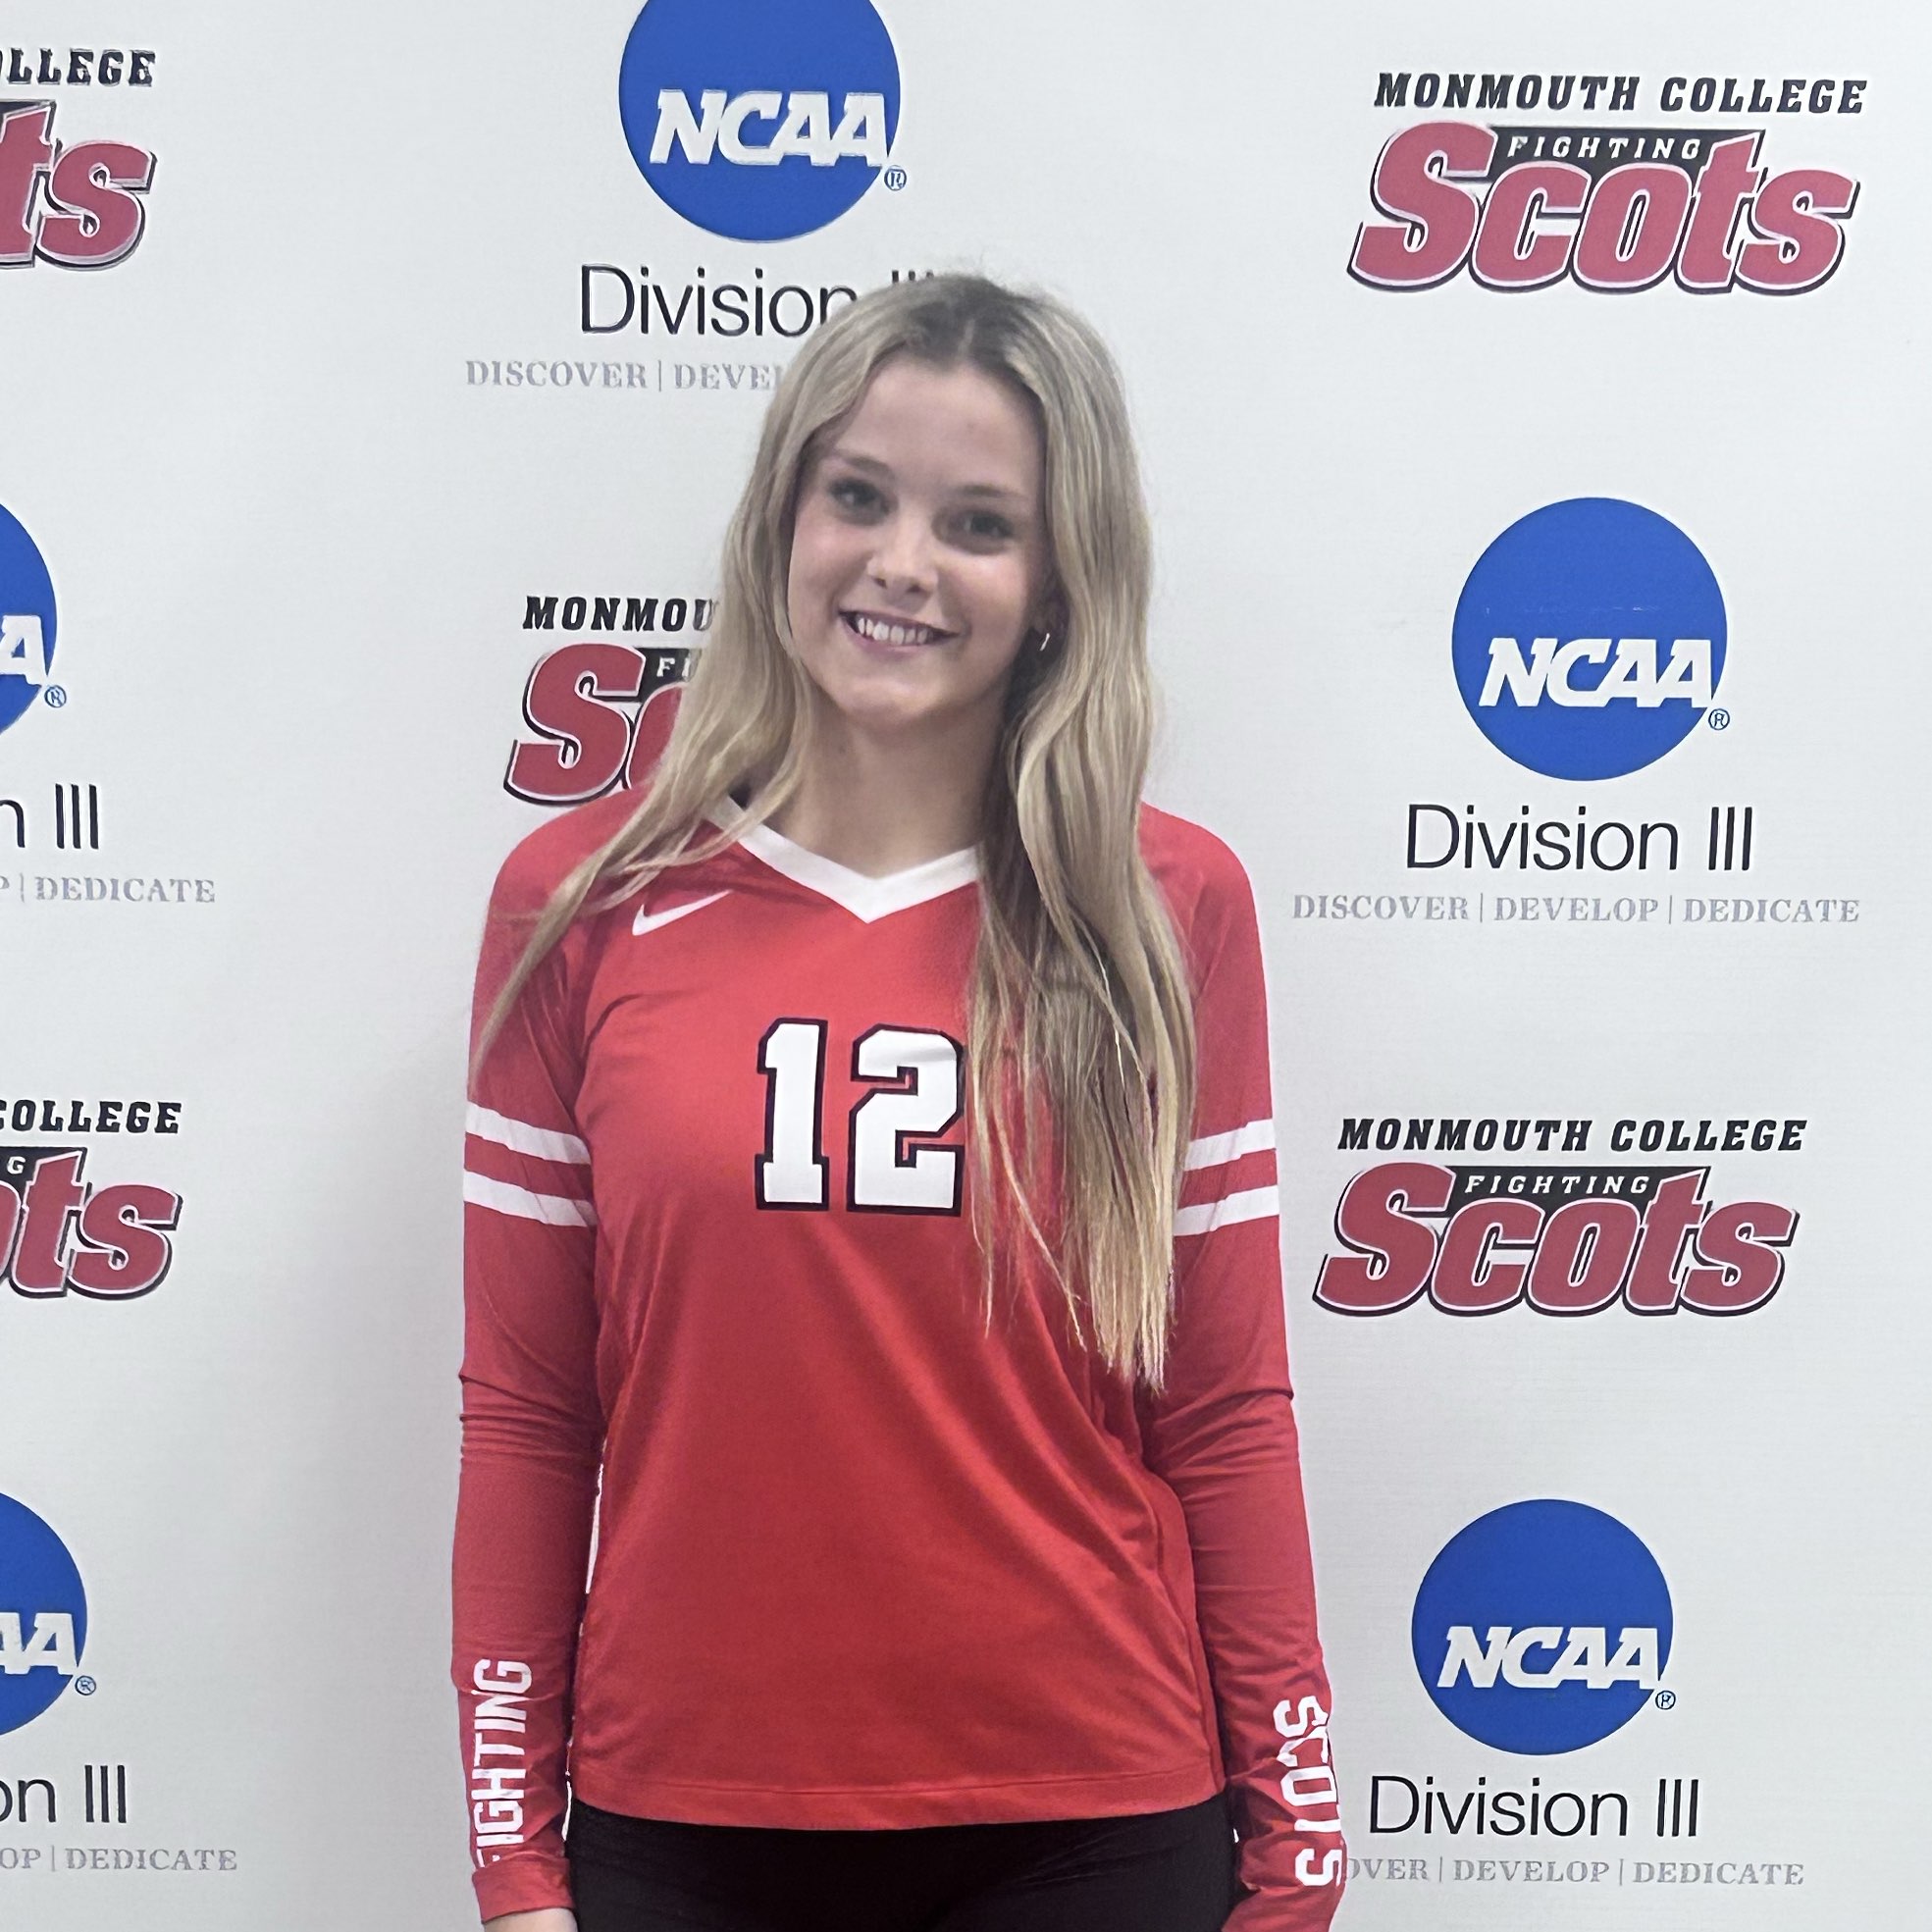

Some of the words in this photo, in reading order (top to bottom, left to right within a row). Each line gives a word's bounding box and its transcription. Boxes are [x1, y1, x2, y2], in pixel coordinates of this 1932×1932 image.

[0, 47, 156, 87] LLEGE
[1374, 72, 1641, 111] MONMOUTH
[1660, 78, 1868, 115] COLLEGE
[649, 88, 887, 168] NCAA
[1507, 135, 1700, 160] FIGHTING
[1346, 120, 1861, 296] Scots
[465, 359, 648, 390] DISCOVER
[1478, 637, 1713, 709] NCAA
[55, 783, 99, 850] III
[1407, 804, 1679, 871] Division
[1708, 806, 1753, 871] III
[34, 876, 216, 904] DEDICATE
[1291, 894, 1470, 921] DISCOVER
[1493, 896, 1659, 922] DEVELOP
[1683, 898, 1860, 924] DEDICATE
[755, 1018, 966, 1217] 12
[1337, 1118, 1593, 1152] MONMOUTH
[1610, 1120, 1808, 1153] COLLEGE
[1465, 1175, 1650, 1194] FIGHTING
[1312, 1162, 1801, 1318] Scots
[1436, 1625, 1660, 1691] NCAA
[84, 1764, 128, 1824] III
[1370, 1775, 1628, 1838] Division
[1656, 1778, 1699, 1838] III
[65, 1848, 237, 1871] DEDICATE
[1452, 1858, 1610, 1883] DEVELOP
[1633, 1861, 1804, 1886] DEDICATE
